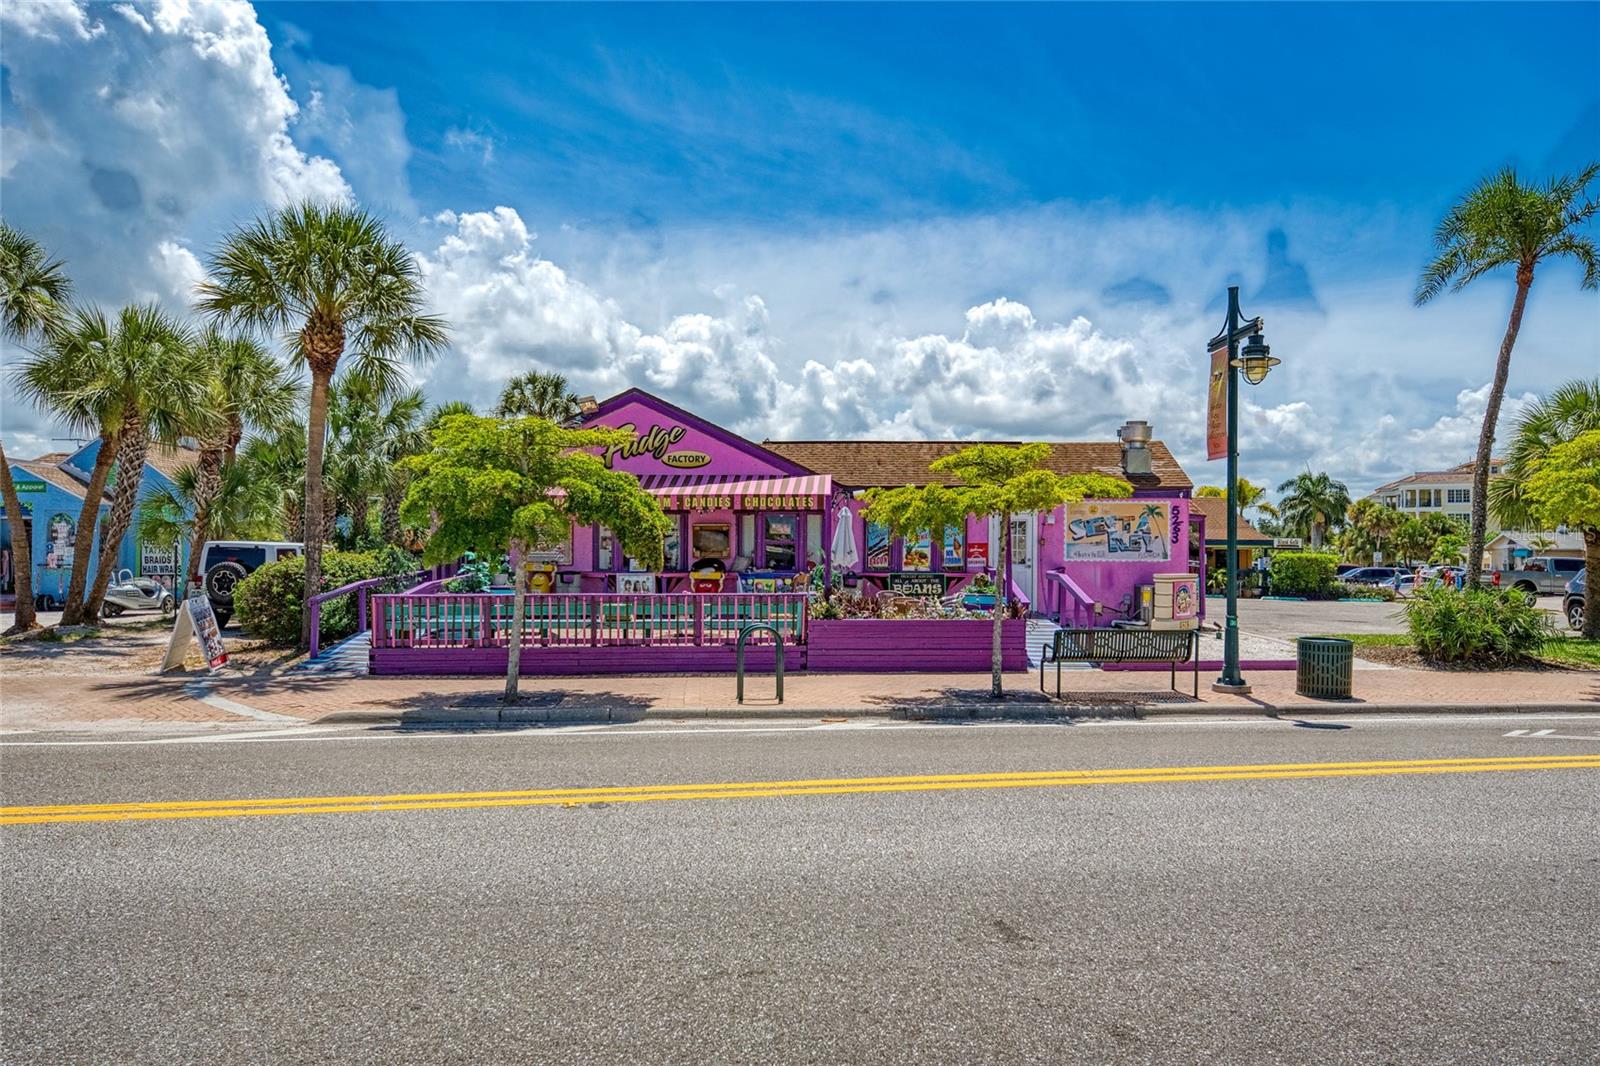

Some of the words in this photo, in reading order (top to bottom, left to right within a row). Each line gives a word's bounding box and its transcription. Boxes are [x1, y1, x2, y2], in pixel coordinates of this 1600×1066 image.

[667, 455, 706, 463] FACTORY
[684, 496, 732, 508] CANDIES
[744, 496, 814, 508] CHOCOLATES
[1171, 505, 1184, 544] 5263
[144, 556, 172, 564] BRAIDS
[142, 565, 158, 573] HAIR
[159, 565, 182, 574] WRAS
[892, 583, 942, 595] BEANS
